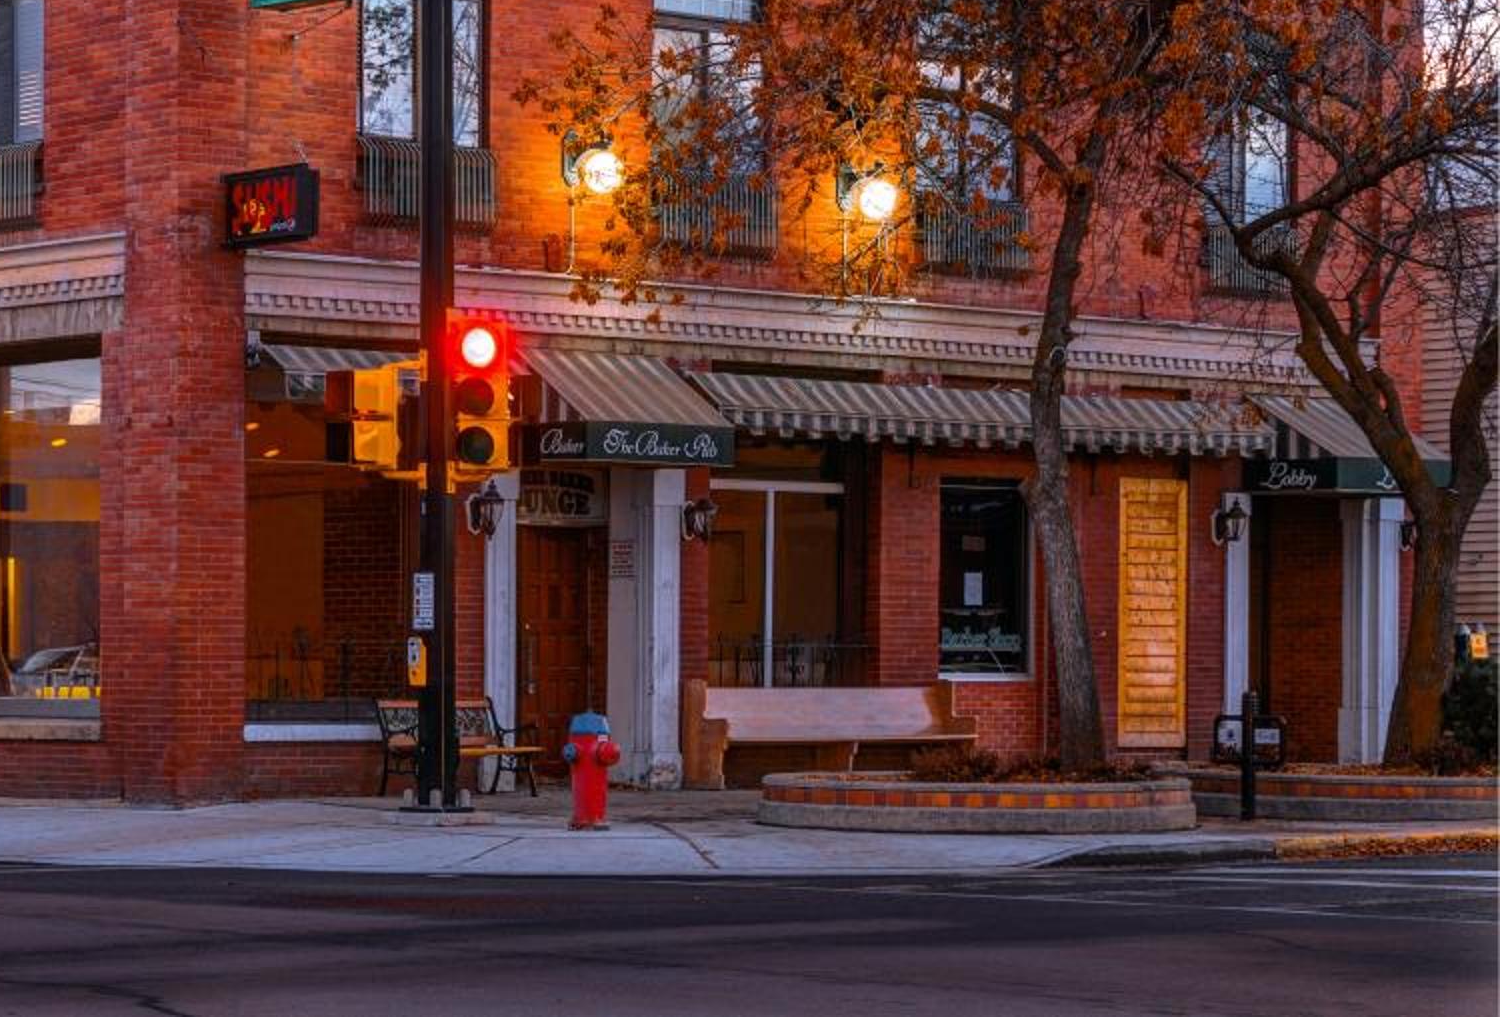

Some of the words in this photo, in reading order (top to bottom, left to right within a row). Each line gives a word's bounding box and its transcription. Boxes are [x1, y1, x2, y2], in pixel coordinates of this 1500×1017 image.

[540, 428, 585, 455] Baker
[603, 428, 635, 455] The
[635, 430, 681, 457] Baker
[1260, 462, 1317, 491] Lobby
